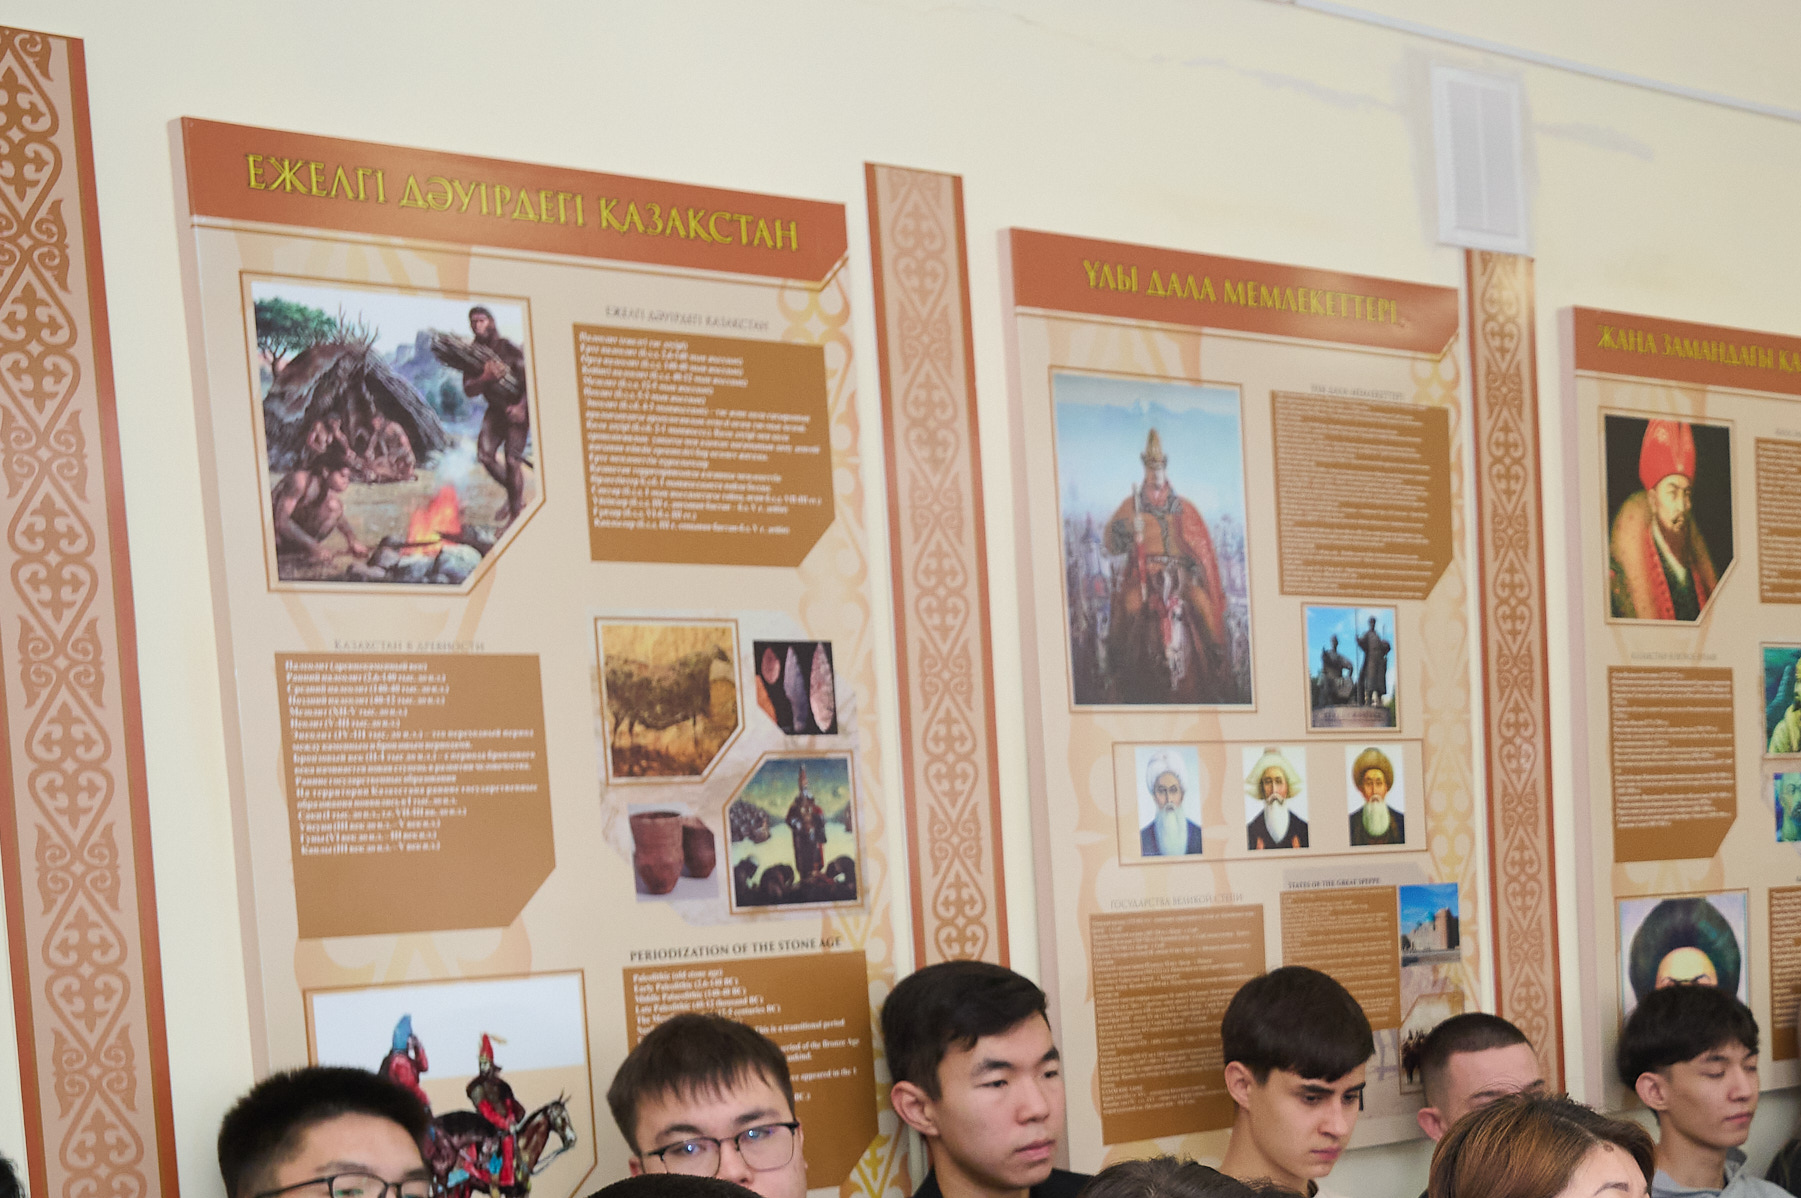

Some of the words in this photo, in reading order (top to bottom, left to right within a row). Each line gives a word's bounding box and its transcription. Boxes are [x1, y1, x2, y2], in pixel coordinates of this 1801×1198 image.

[245, 153, 387, 204] ЕЖЕЛГІ
[399, 173, 586, 228] ДӘУІРДЕГІ
[1146, 269, 1217, 302] ДАЛА
[1224, 278, 1398, 325] МЕМЛЕКЕТТЕРІ
[630, 944, 729, 961] PERIODIZATION
[732, 942, 749, 954] OF
[752, 940, 775, 953] THE
[777, 938, 817, 950] STONE
[818, 936, 842, 948] AGE
